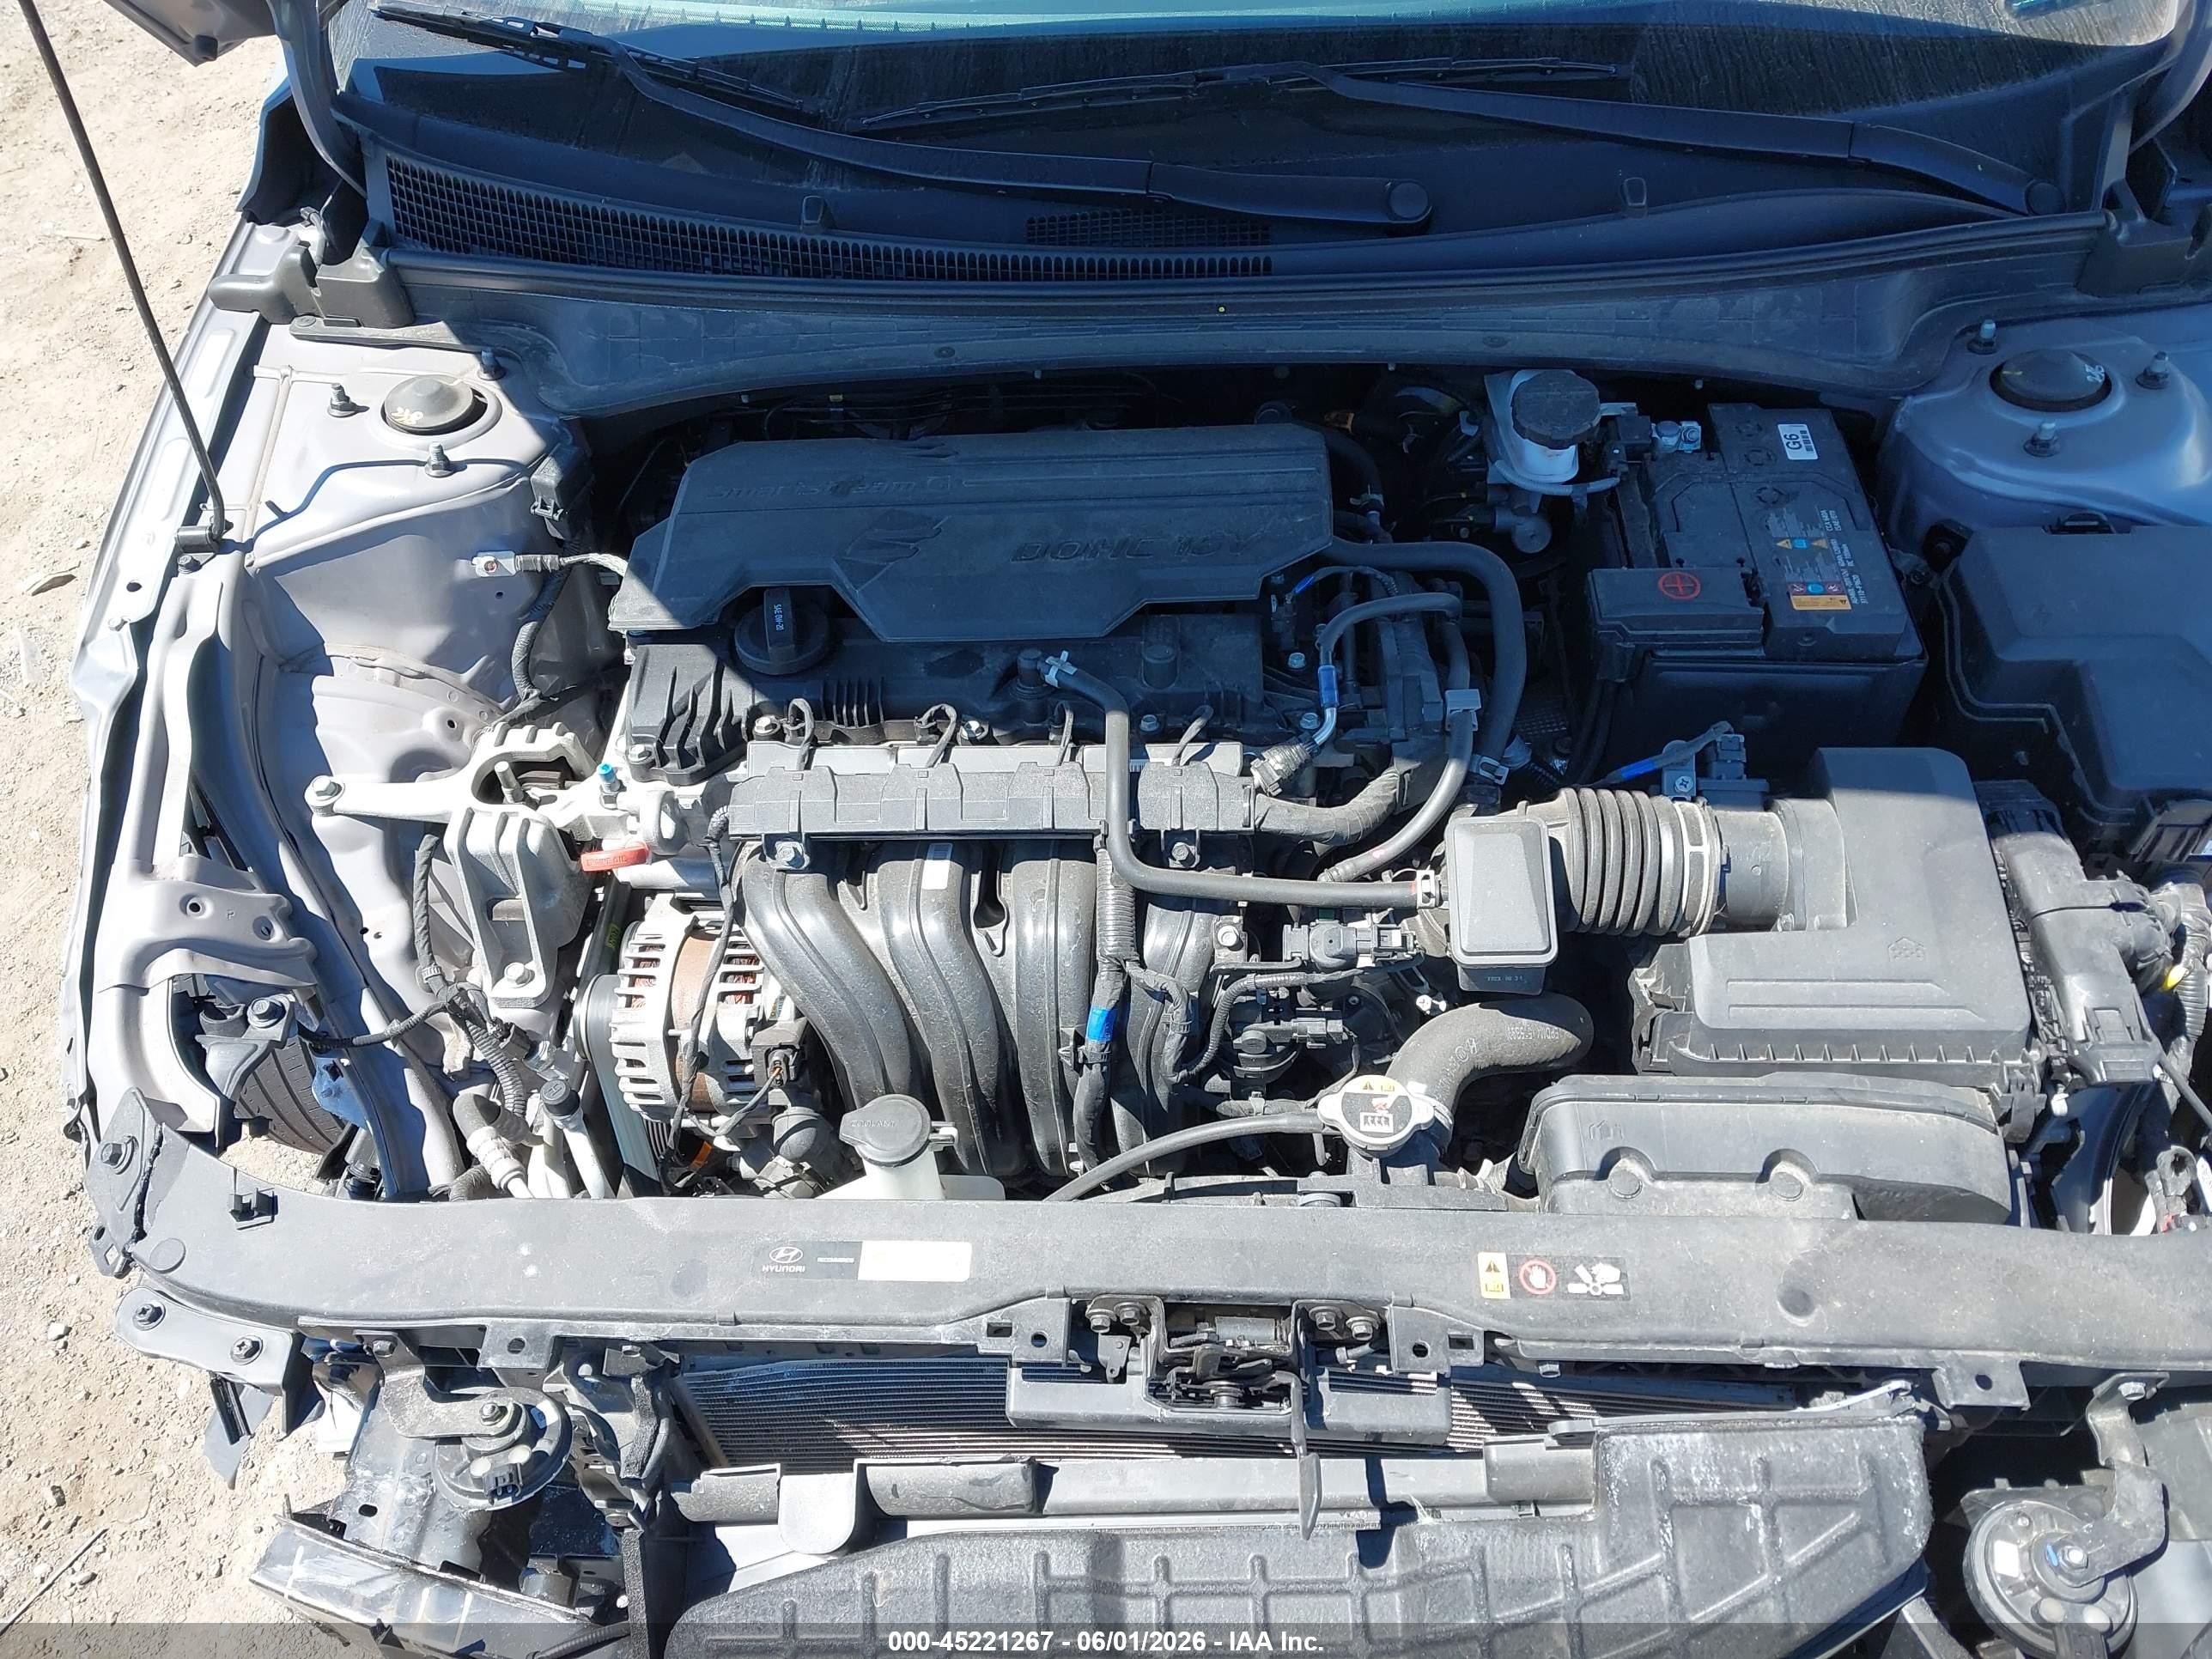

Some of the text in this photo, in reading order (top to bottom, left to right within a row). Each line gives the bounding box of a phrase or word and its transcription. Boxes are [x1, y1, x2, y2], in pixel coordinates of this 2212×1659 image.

[1783, 433, 1802, 451] G6
[1010, 533, 1161, 562] DOHC
[762, 1264, 805, 1273] HYUNDAI
